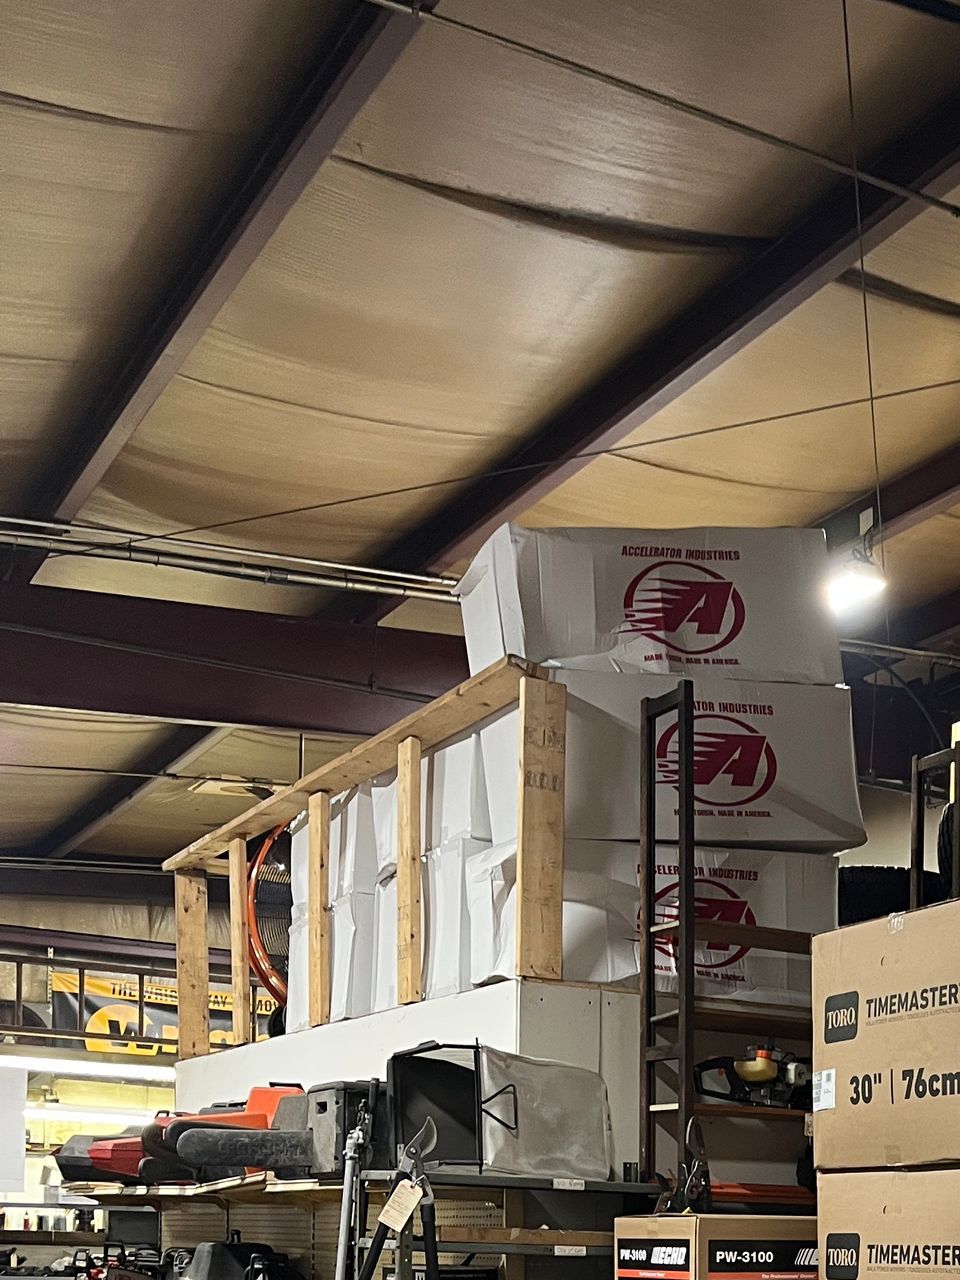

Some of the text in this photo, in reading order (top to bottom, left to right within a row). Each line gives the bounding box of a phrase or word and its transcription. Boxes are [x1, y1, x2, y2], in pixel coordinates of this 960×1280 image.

[621, 545, 741, 561] ACCELERATOR INDUSTRIES
[718, 702, 774, 716] INDUSTRIES
[708, 867, 758, 882] INDUSTRIES
[111, 983, 136, 998] THE
[866, 984, 960, 1018] TIMEMASTER
[827, 1007, 855, 1030] TORO
[620, 1247, 687, 1265] PW-3100 ECHO
[716, 1252, 773, 1263] PW-3100
[828, 1248, 856, 1266] TORO
